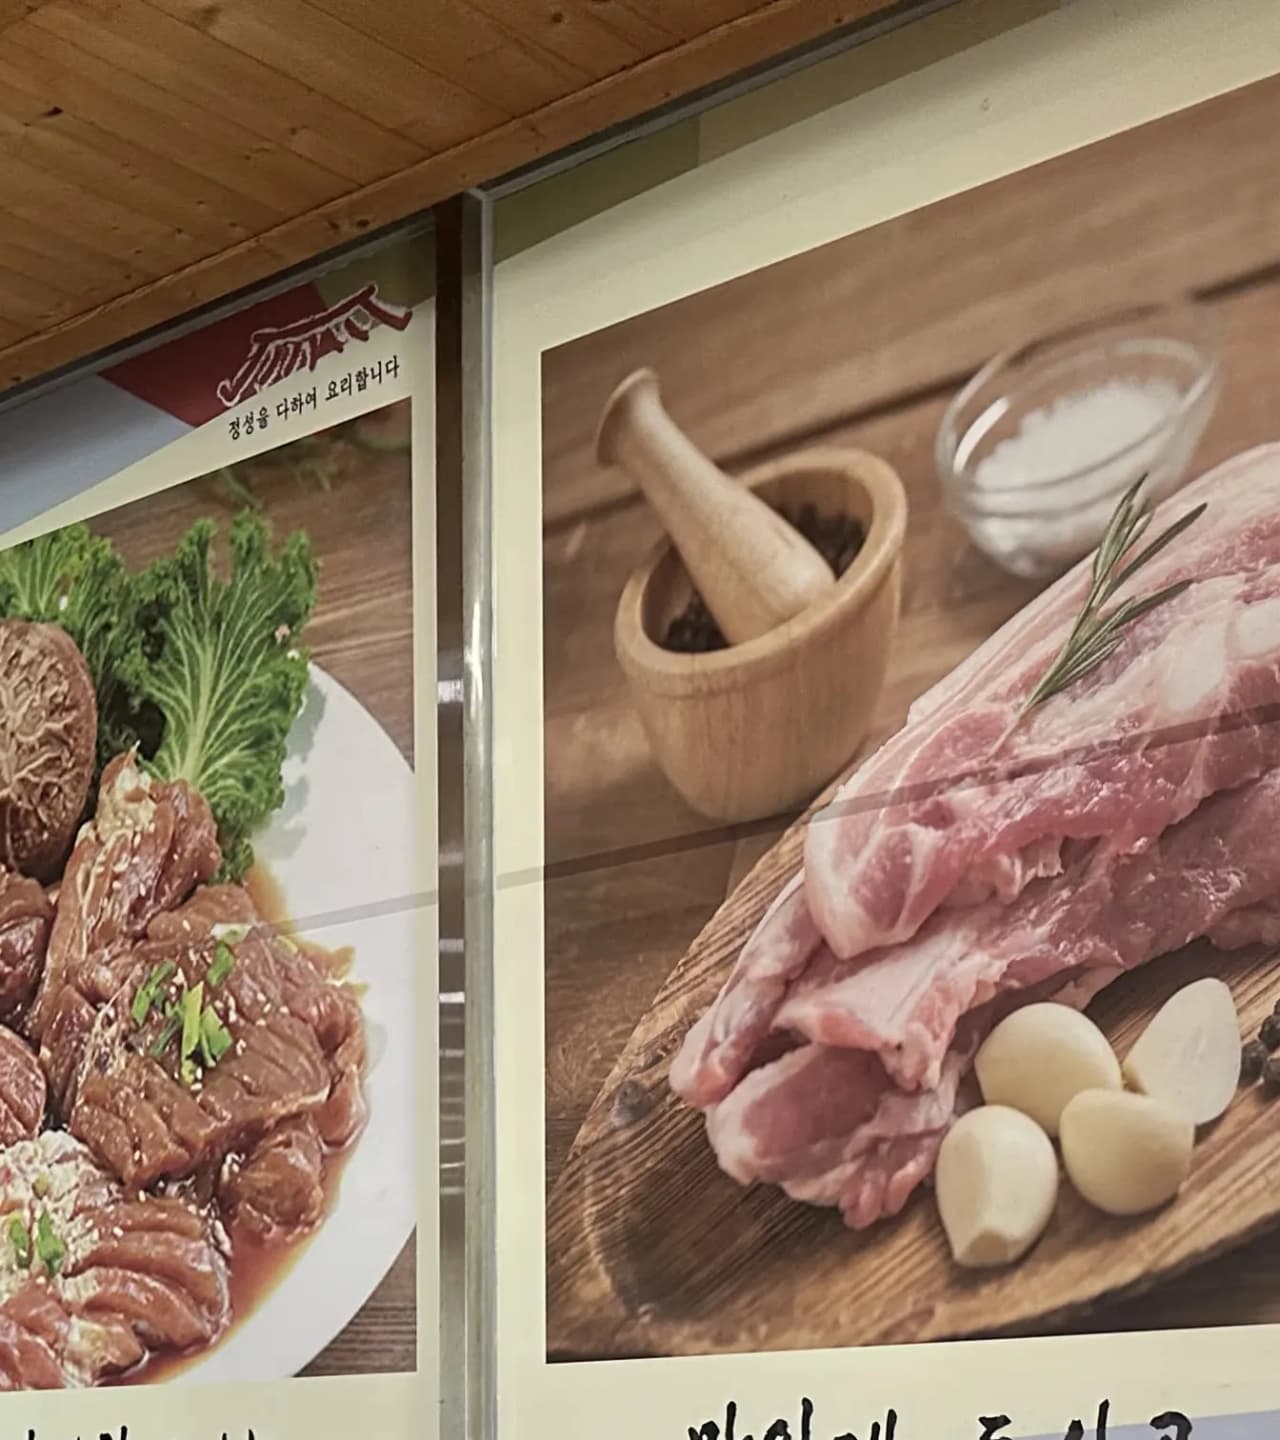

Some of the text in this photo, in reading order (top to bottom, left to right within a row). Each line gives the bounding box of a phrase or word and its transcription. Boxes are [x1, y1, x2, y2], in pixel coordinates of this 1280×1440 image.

[227, 355, 401, 440] 정성을 다하여 요리합니다
